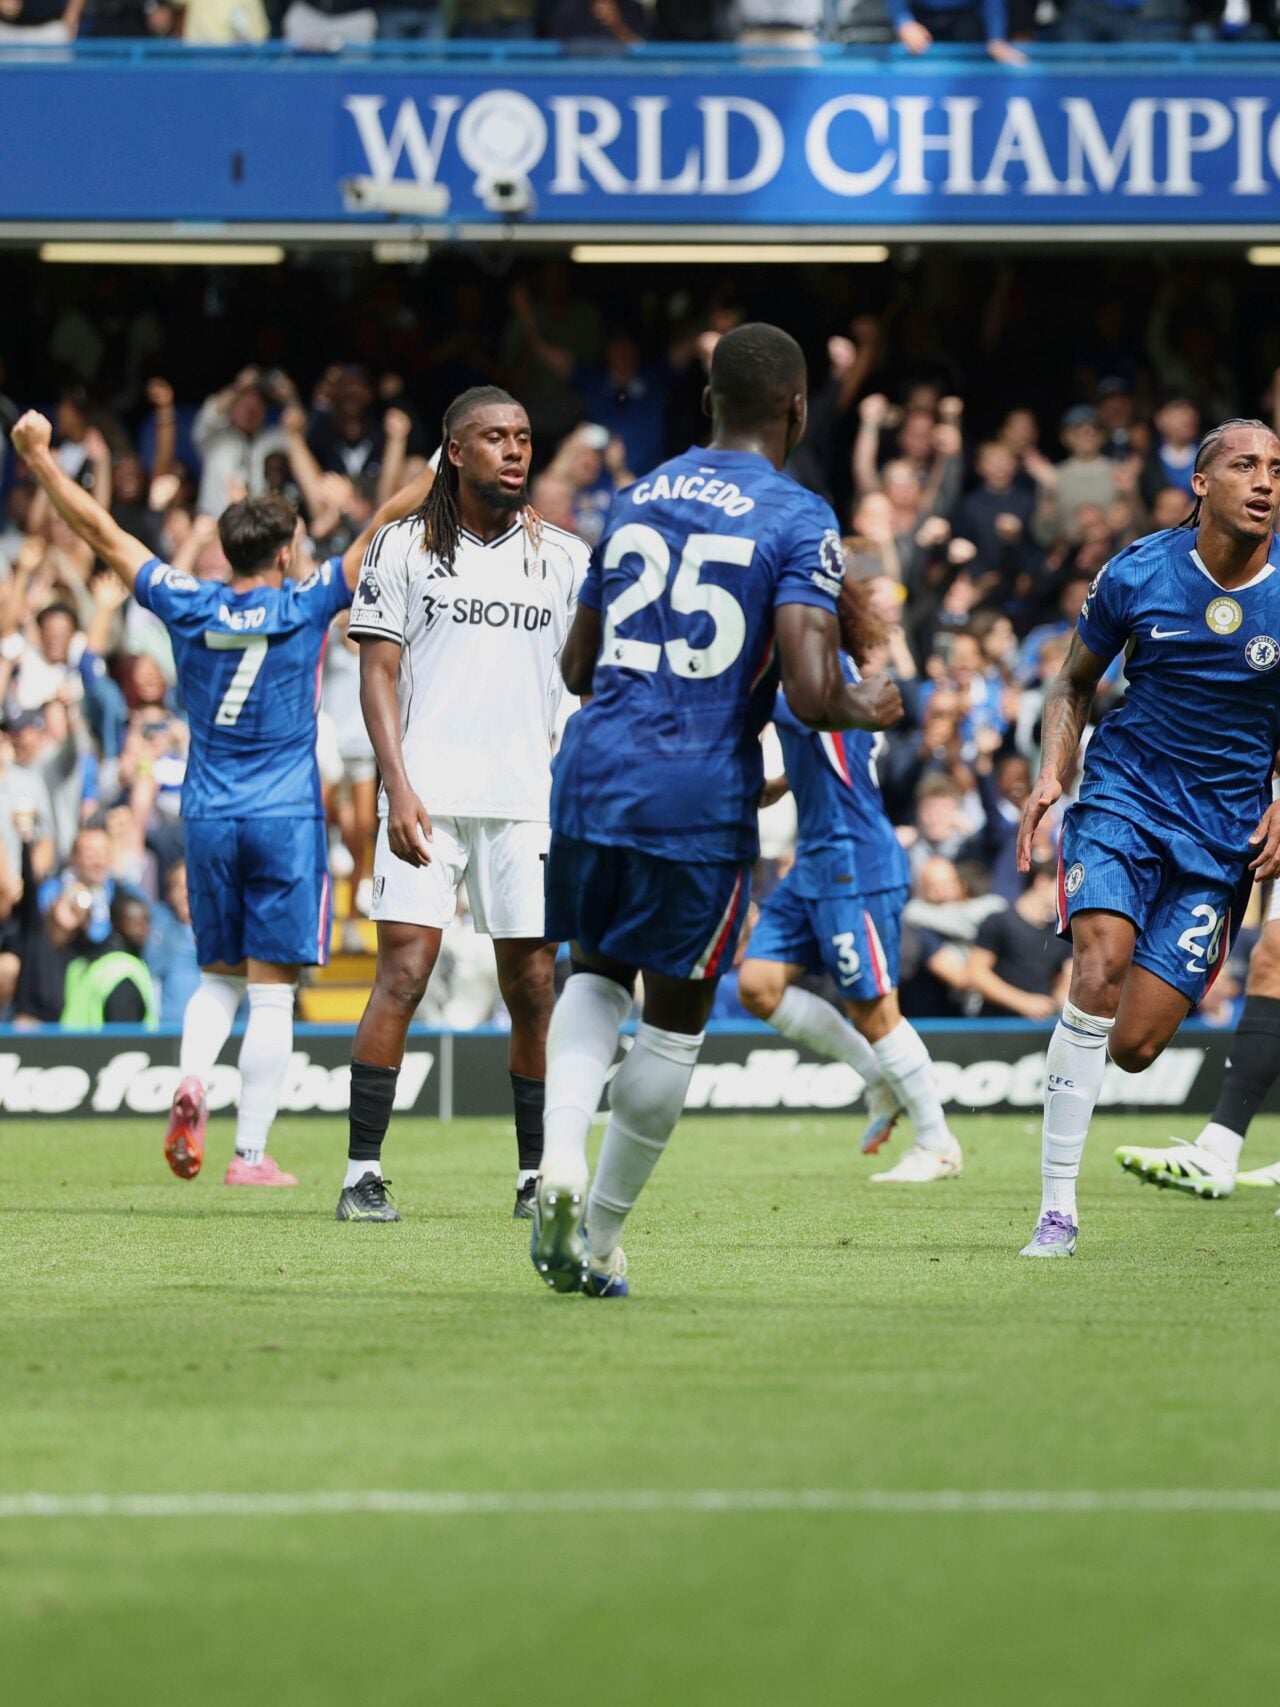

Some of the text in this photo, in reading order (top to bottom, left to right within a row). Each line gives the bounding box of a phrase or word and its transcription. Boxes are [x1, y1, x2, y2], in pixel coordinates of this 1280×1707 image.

[343, 89, 785, 197] WORLD
[632, 475, 755, 517] CAICEDO
[452, 598, 552, 632] SBOTOP
[597, 523, 756, 679] 25
[204, 629, 268, 726] 7
[831, 931, 860, 975] 3
[1049, 1074, 1074, 1089] CFC
